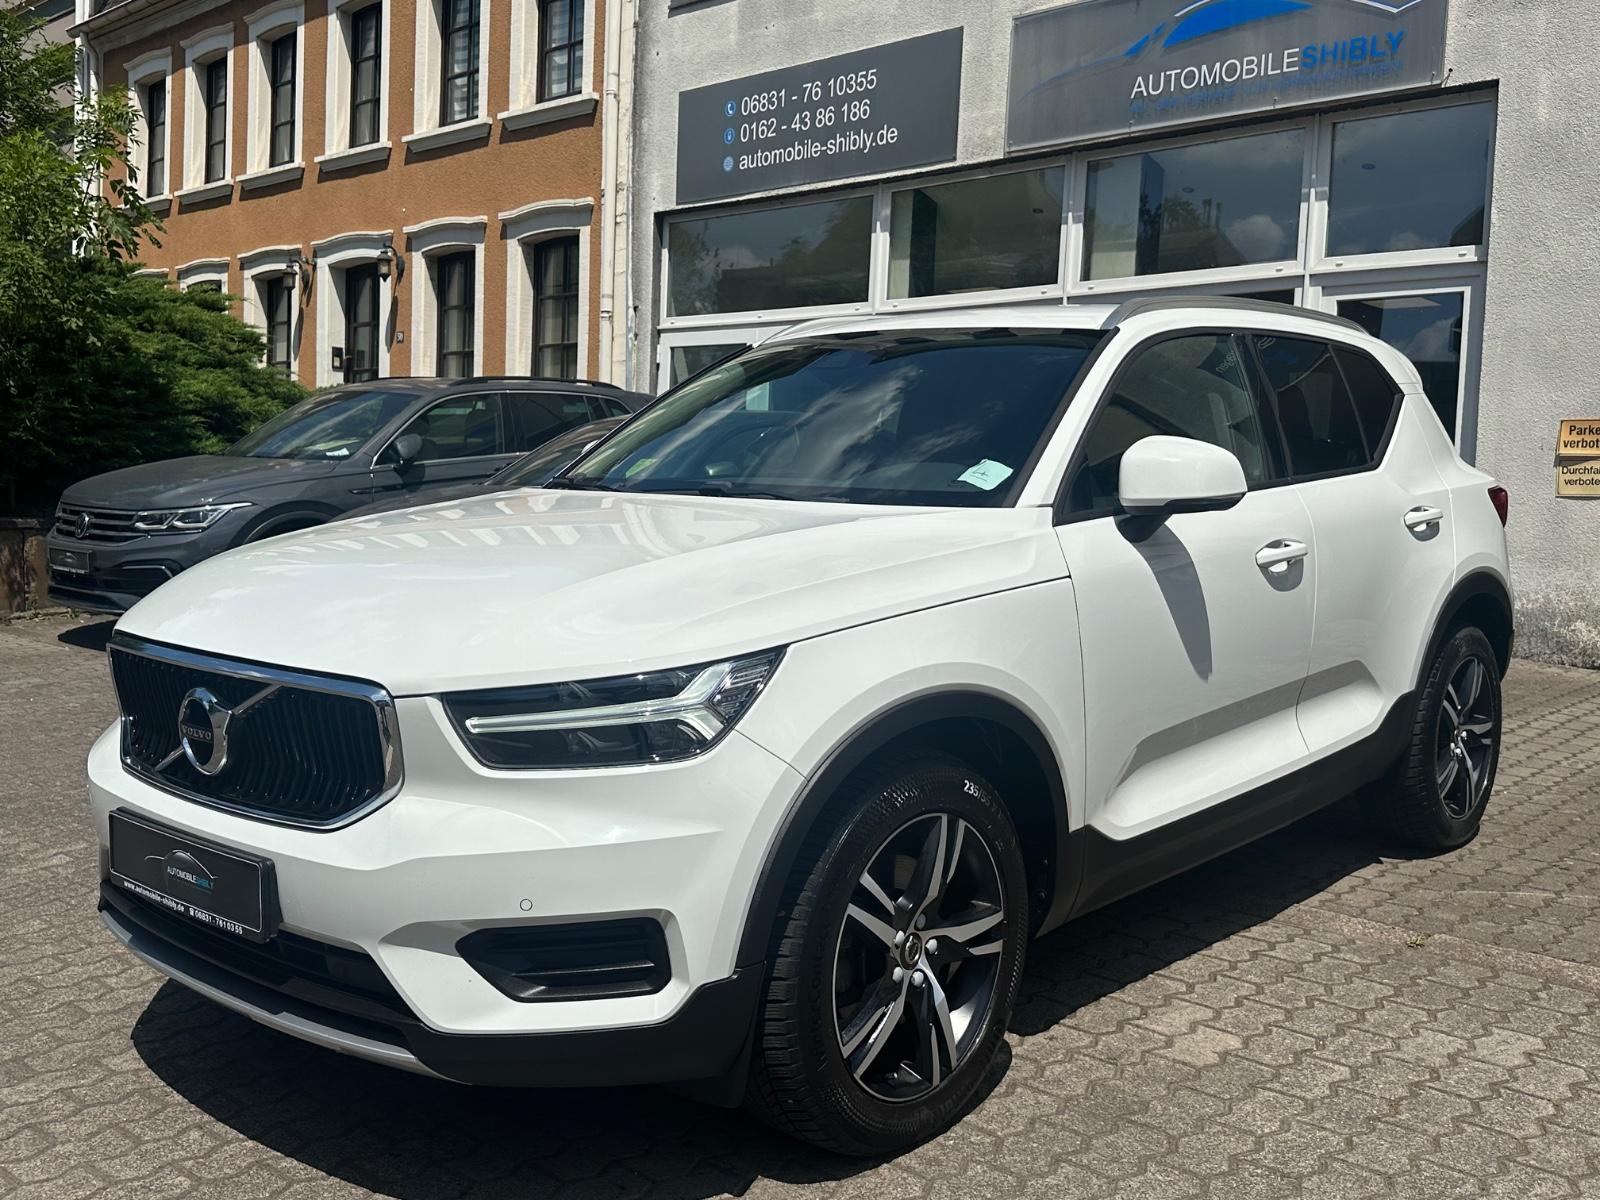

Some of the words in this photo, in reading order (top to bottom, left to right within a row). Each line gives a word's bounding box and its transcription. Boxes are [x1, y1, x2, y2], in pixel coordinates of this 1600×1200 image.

[740, 88, 786, 116] 06831
[802, 81, 821, 103] 76
[828, 68, 877, 98] 10355
[740, 117, 777, 143] 0162
[790, 111, 811, 133] 43
[815, 105, 835, 127] 86
[841, 99, 871, 122] 186
[739, 124, 898, 170] automobile-shibly.de
[182, 725, 212, 740] VOLVO
